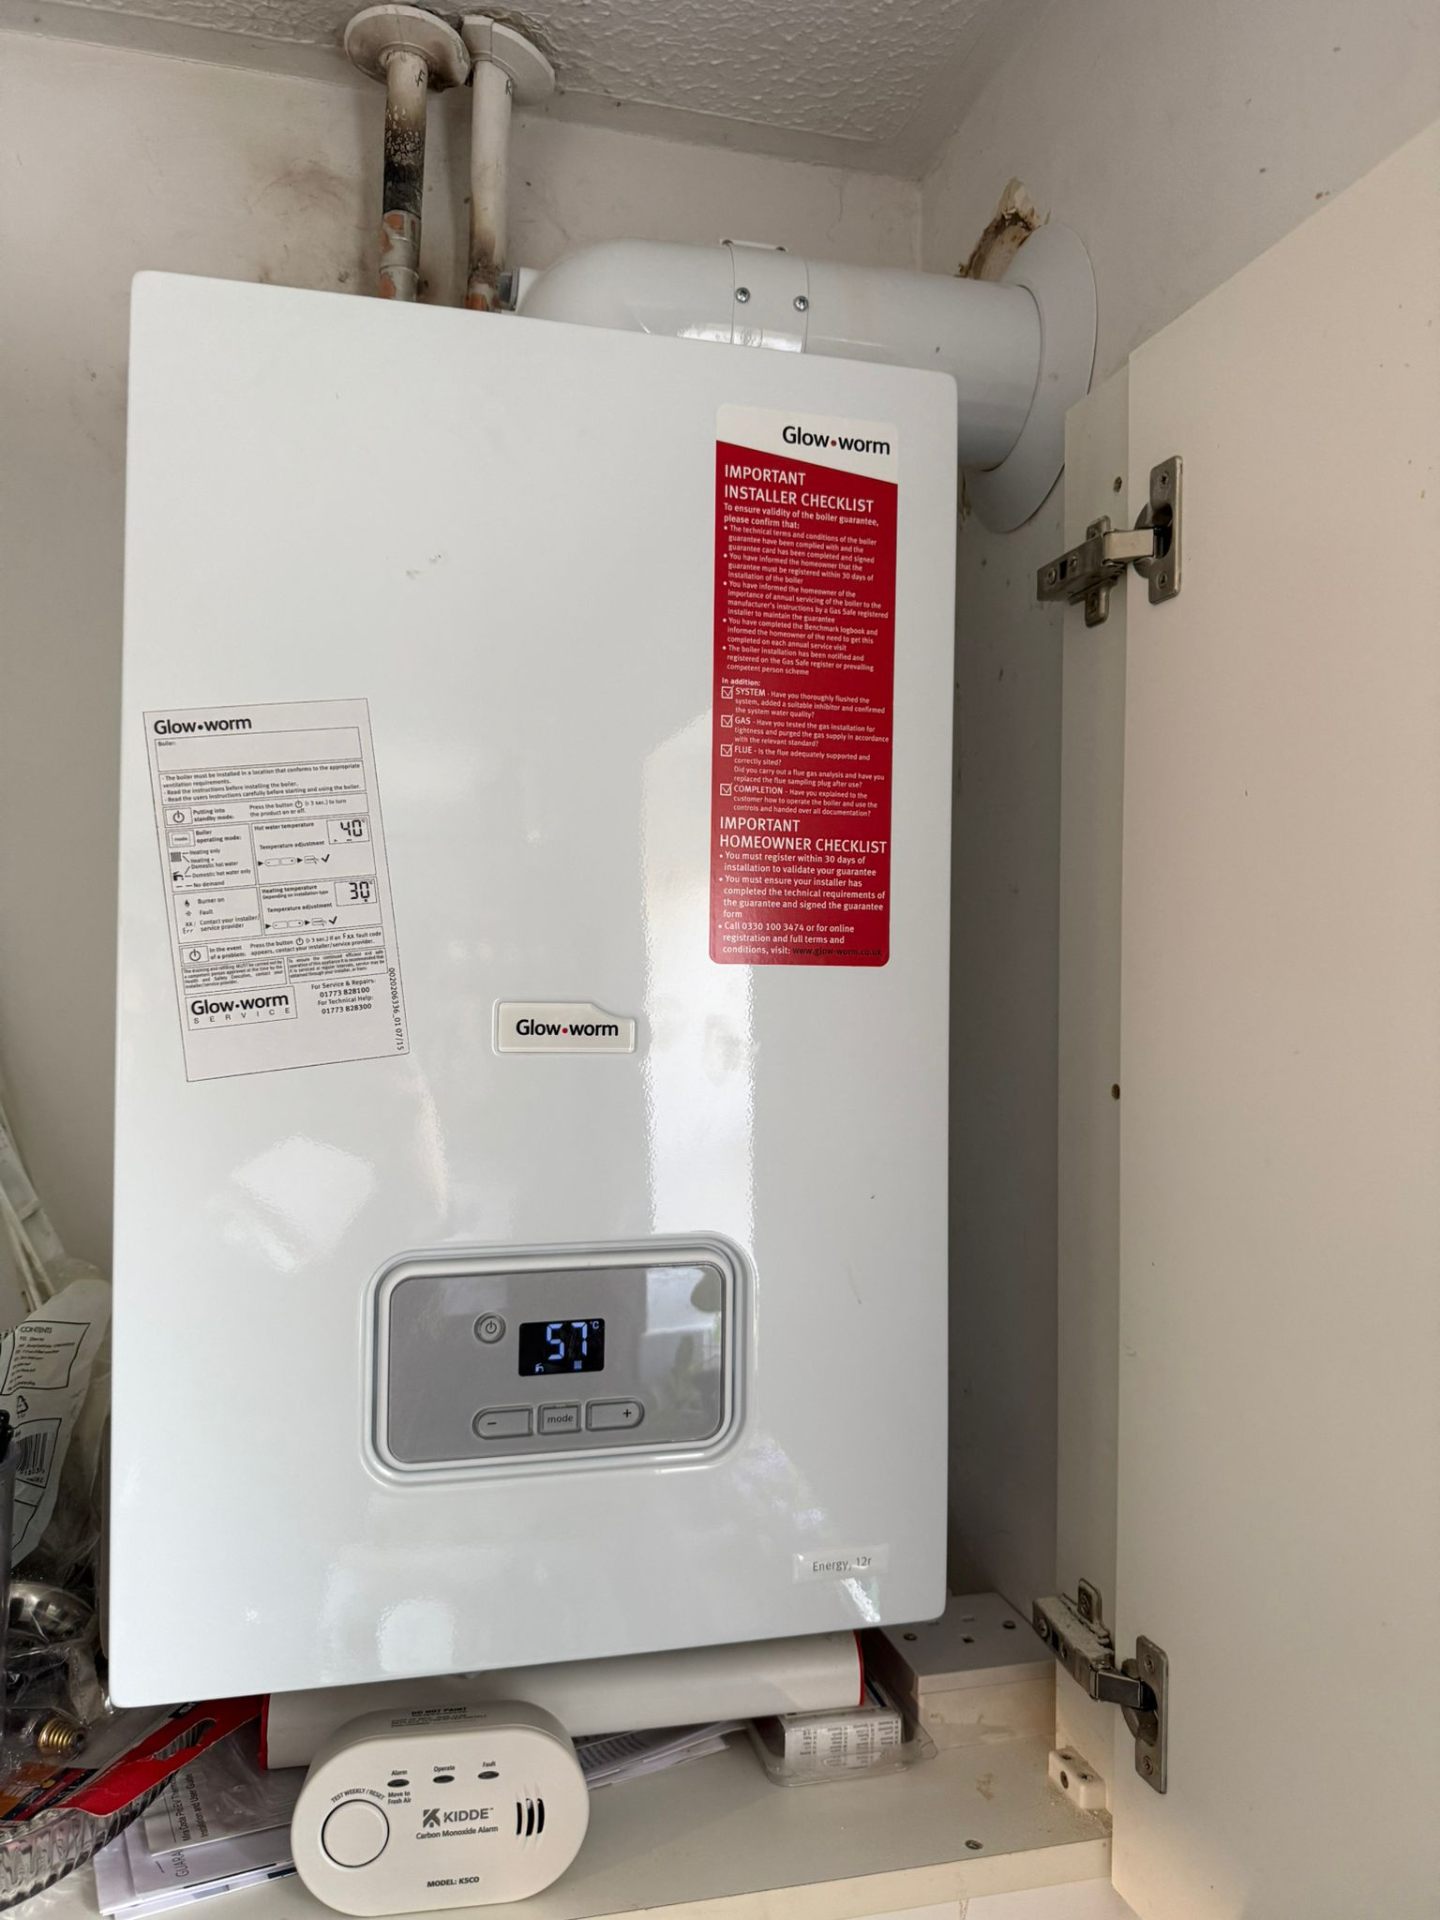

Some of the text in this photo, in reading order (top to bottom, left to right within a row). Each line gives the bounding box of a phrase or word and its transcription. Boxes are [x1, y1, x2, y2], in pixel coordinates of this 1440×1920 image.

[724, 464, 806, 486] IMPORTANT
[724, 486, 874, 512] INSTALLER CHECKLIST
[724, 503, 879, 527] To ensure validity of the boiler guarantee,
[724, 515, 800, 528] please confirm that:
[193, 808, 213, 816] Putting
[733, 804, 759, 812] controls
[821, 808, 871, 816] documentation?
[193, 815, 215, 823] standby
[720, 816, 800, 832] IMPORTANT
[280, 821, 315, 830] temperature
[340, 820, 362, 837] 40
[196, 836, 223, 844] operating
[259, 840, 325, 851] Temperature adjustment
[720, 835, 887, 853] HOMEOWNER CHECKLIST
[725, 851, 866, 866] You must register within 30 days of
[724, 864, 877, 878] installation to validate your guarantee
[725, 875, 740, 883] You
[741, 875, 762, 884] must
[793, 879, 811, 887] your
[813, 878, 845, 886] installer
[847, 878, 862, 887] has
[261, 884, 317, 895] Heating temperature
[349, 882, 370, 900] 30
[723, 887, 885, 901] completed the technical requirements of
[267, 902, 332, 914] Temperature adjustment
[723, 898, 883, 912] the guarantee and signed the guarantee
[723, 909, 743, 918] form
[724, 922, 740, 930] Call
[741, 922, 764, 930] 0330
[764, 922, 781, 931] 100
[782, 923, 804, 931] 3474
[815, 923, 827, 932] for
[829, 924, 855, 932] online
[723, 933, 845, 944] registration and full terms and
[722, 945, 768, 955] conditions,
[770, 946, 791, 954] visit:
[321, 981, 344, 989] Service
[351, 979, 376, 988] Repairs:
[342, 987, 370, 995] 828100
[328, 997, 356, 1005] Technical
[357, 995, 374, 1004] Help:
[344, 1004, 372, 1012] 828300
[395, 1028, 404, 1050] 07/15
[546, 1321, 588, 1360] 57
[547, 1414, 574, 1424] mode
[434, 1764, 455, 1773] Operate
[482, 1760, 496, 1768] Fault
[330, 1790, 344, 1804] TEST
[344, 1788, 366, 1797] WEEKLY
[369, 1788, 386, 1800] RESET
[402, 1796, 411, 1804] Air
[416, 1825, 498, 1840] Carbon Monoxide Alarm
[427, 1878, 457, 1888] MODEL:
